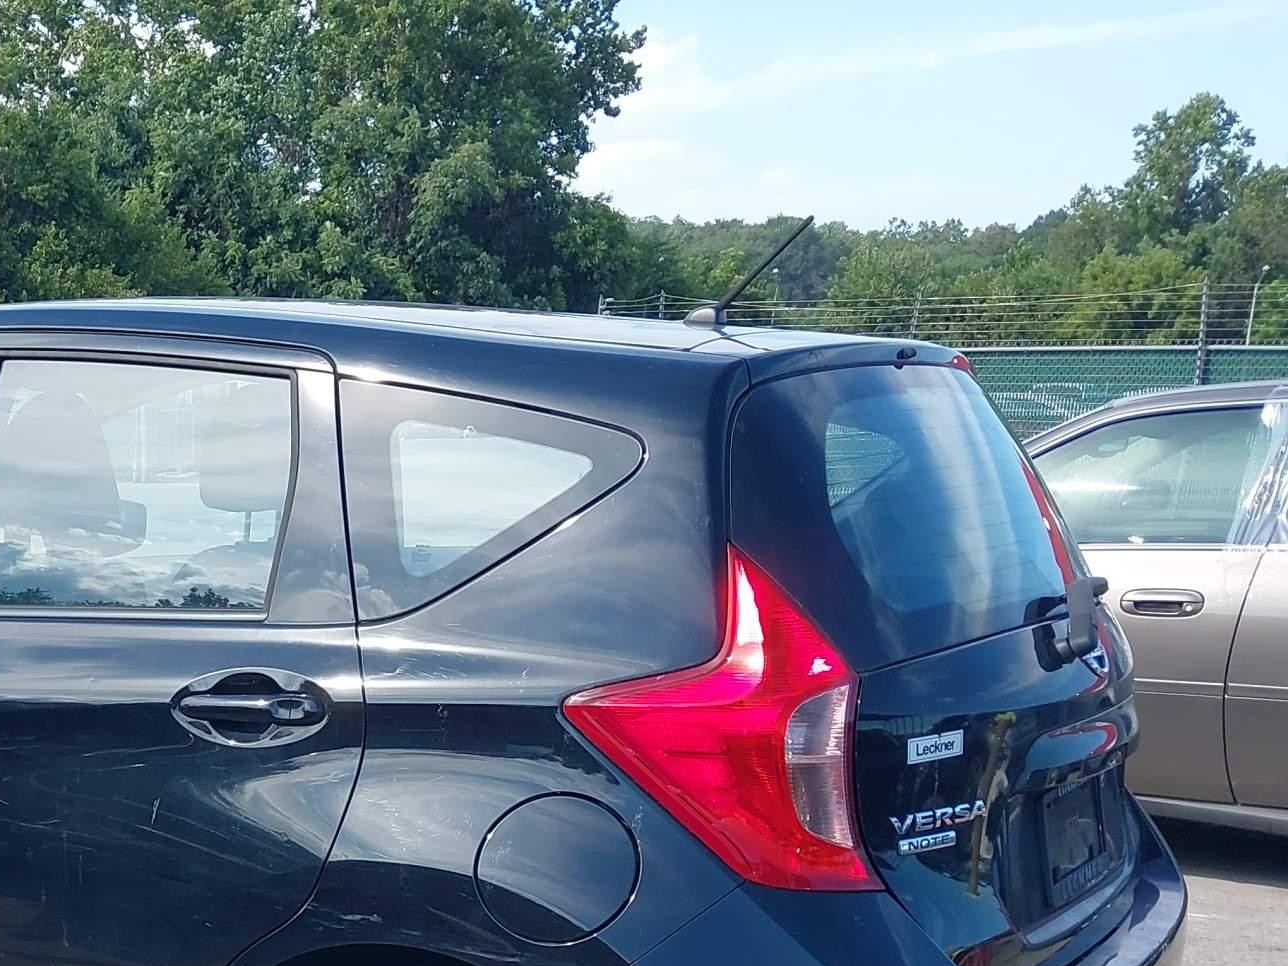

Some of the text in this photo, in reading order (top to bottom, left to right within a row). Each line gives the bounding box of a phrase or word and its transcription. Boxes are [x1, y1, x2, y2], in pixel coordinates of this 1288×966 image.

[916, 740, 956, 757] Leckner
[889, 800, 987, 835] VERSA
[908, 835, 952, 852] NOTE
